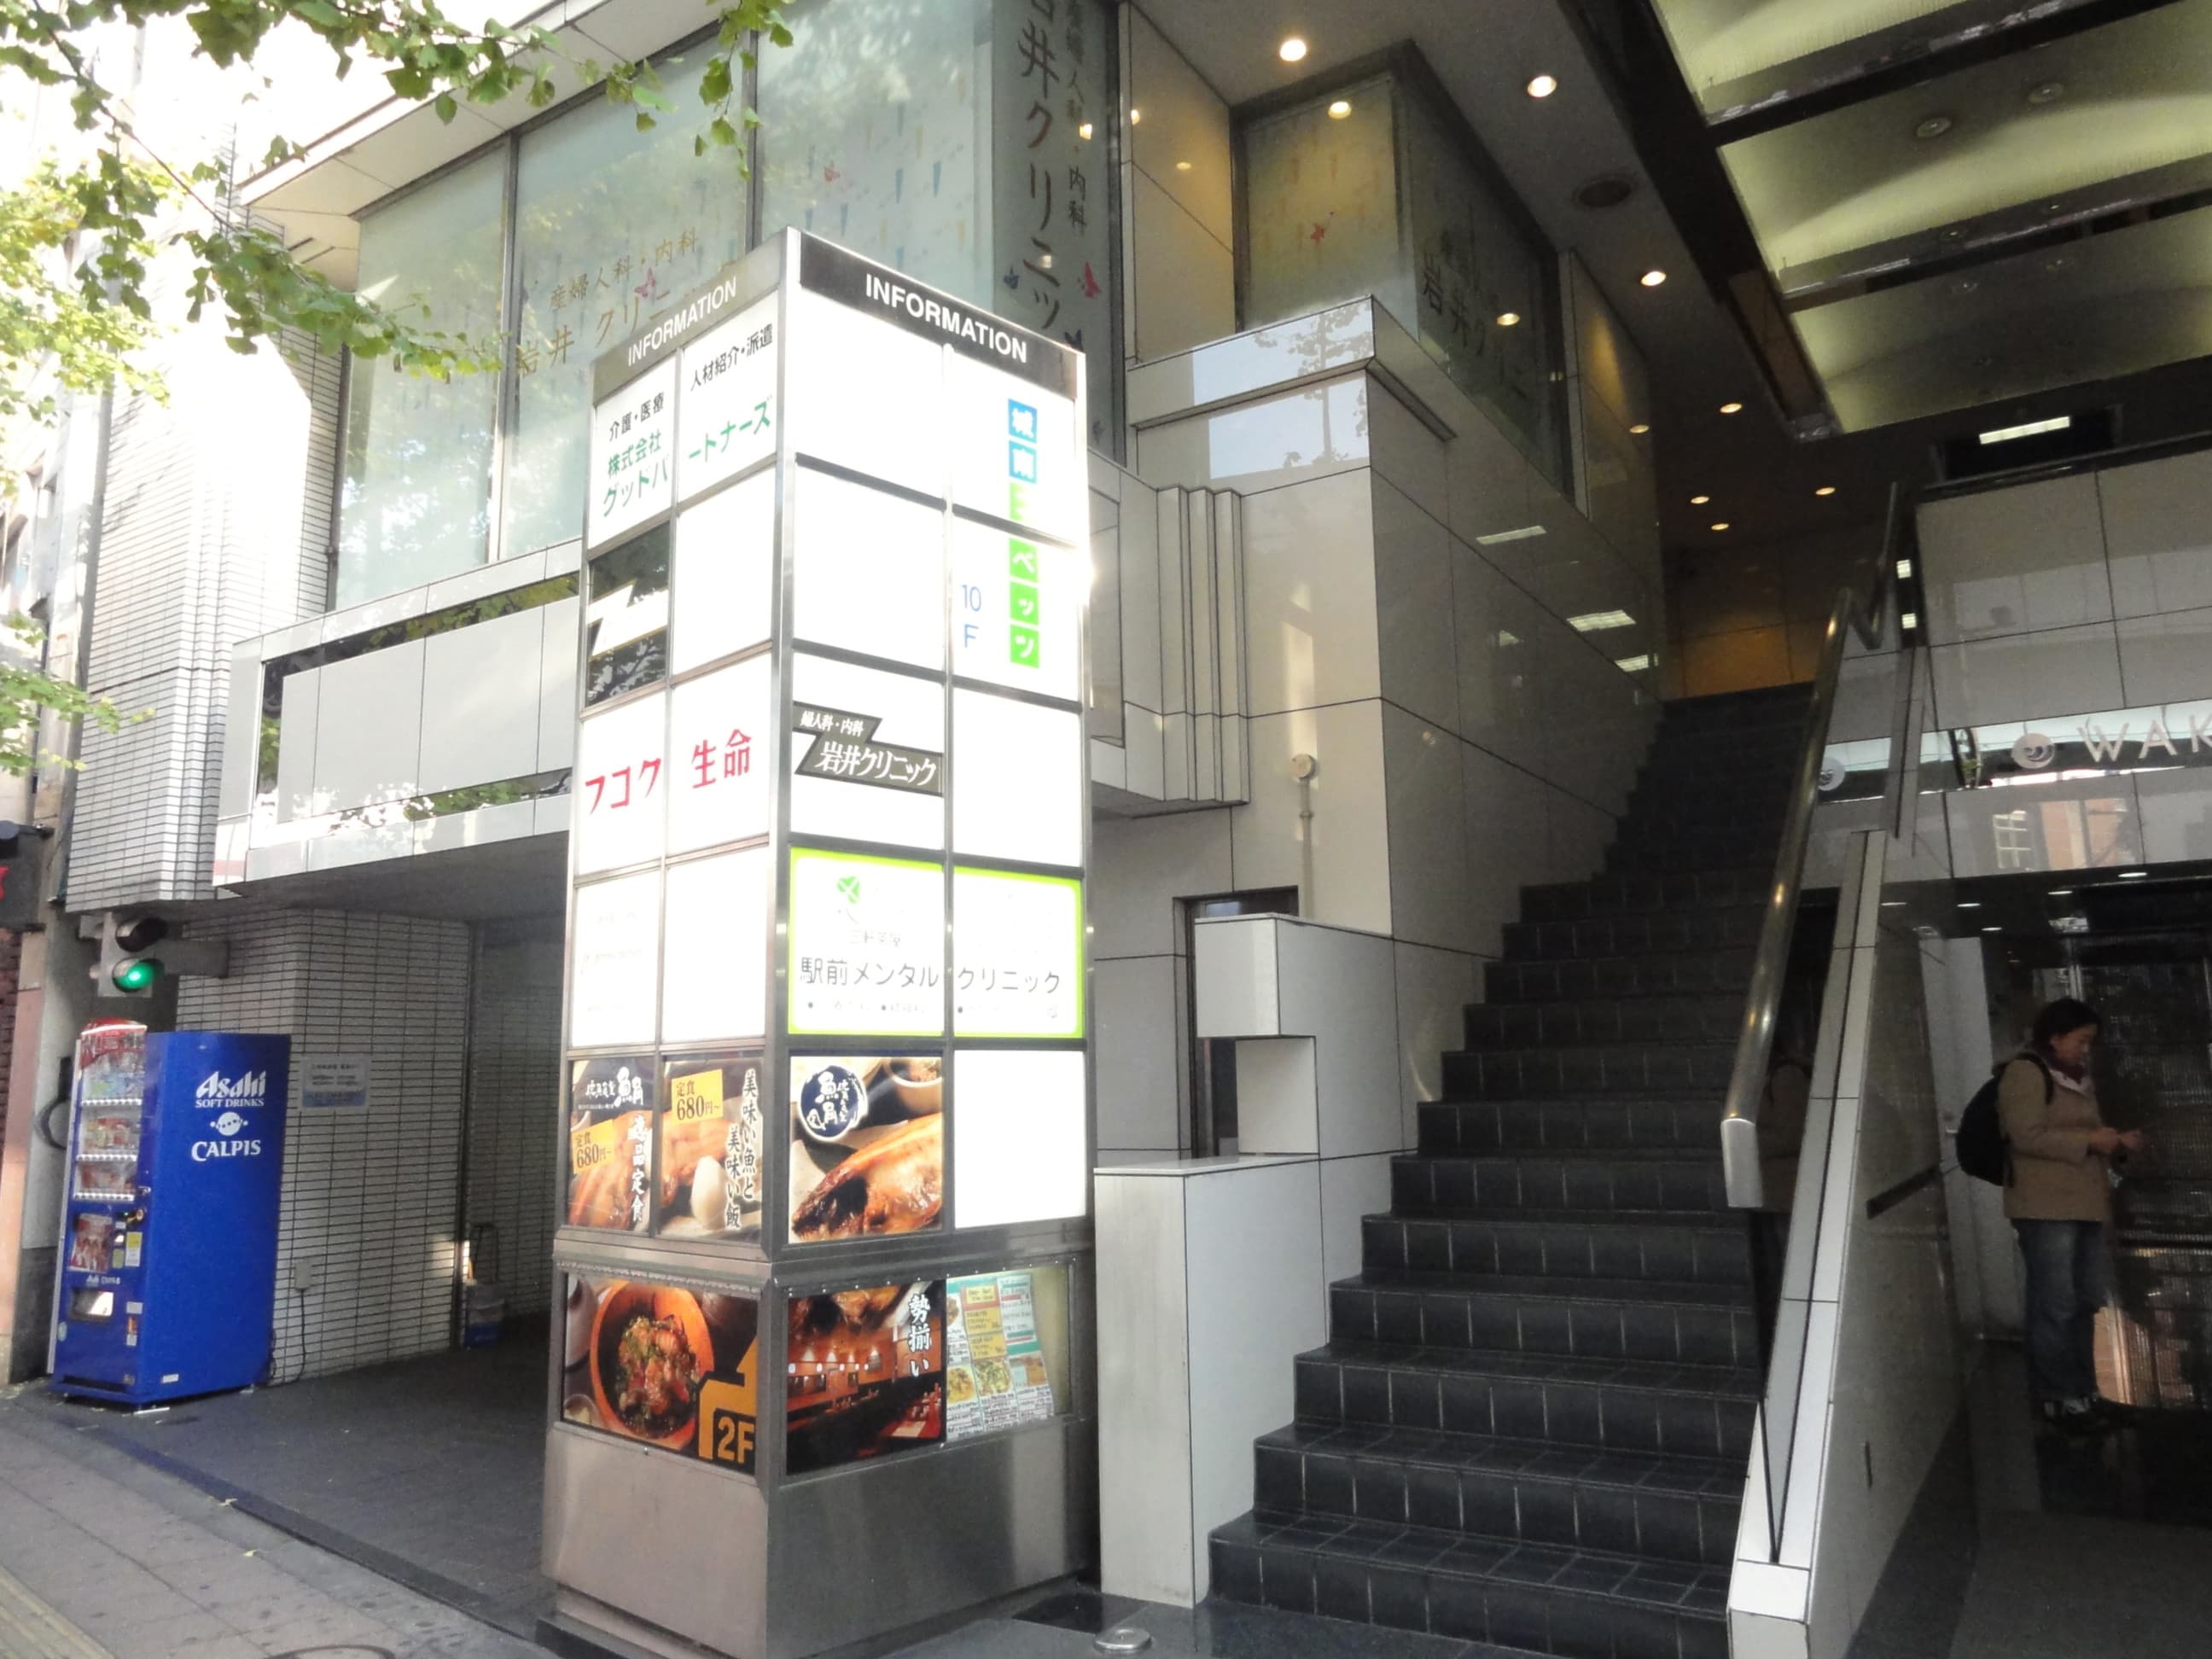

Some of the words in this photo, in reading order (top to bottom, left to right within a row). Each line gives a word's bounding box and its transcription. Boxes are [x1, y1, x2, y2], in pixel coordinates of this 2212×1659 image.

[627, 276, 737, 367] INFORMATION
[865, 273, 1027, 364] INFORMATION
[607, 428, 662, 478] 株式会社
[585, 757, 662, 816] フコク
[690, 728, 753, 790] 生命
[814, 741, 937, 787] 岩井クリニック
[195, 1070, 267, 1099] Asahi
[195, 1098, 224, 1109] SOFT
[225, 1097, 265, 1108] DRINKS
[676, 1080, 696, 1097] 定食
[190, 1139, 262, 1162] CALPIS
[742, 1070, 758, 1200] 美味い魚と
[726, 1126, 741, 1228] 美味い飯
[907, 1293, 932, 1377] 勢揃い
[717, 1415, 755, 1464] 2F
